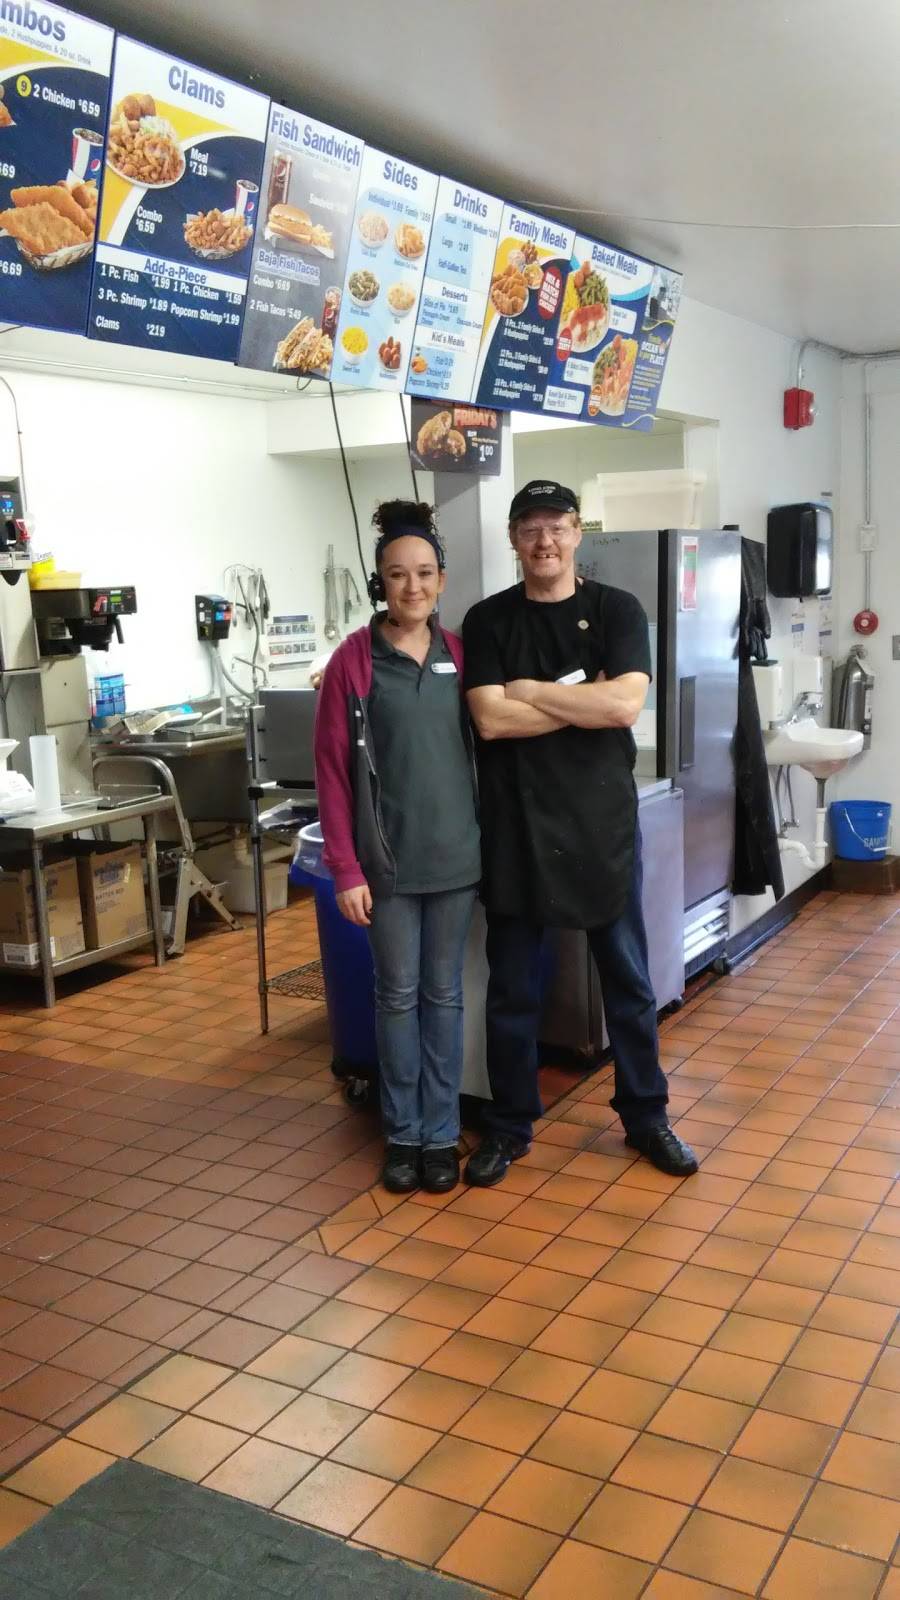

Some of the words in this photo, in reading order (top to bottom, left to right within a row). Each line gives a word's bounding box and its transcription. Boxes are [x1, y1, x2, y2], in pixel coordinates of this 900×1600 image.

[21, 80, 28, 92] 9
[33, 84, 40, 98] 2
[42, 86, 76, 111] Chicken
[169, 65, 226, 109] Clams
[271, 110, 299, 142] Fish
[303, 124, 361, 167] Sandwich
[190, 147, 209, 164] Meal
[383, 160, 418, 191] Sides
[137, 205, 163, 222] Combo
[454, 189, 488, 218] Drinks
[509, 214, 541, 242] Family
[542, 226, 568, 250] Meals
[144, 257, 207, 284] Add-a-Piece
[259, 250, 277, 266] Baja
[279, 256, 296, 271] Fish
[297, 261, 320, 277] Tacos
[592, 245, 617, 267] Baked
[617, 254, 638, 275] Meals
[101, 265, 106, 276] 1
[109, 267, 121, 279] Pc.
[123, 269, 139, 283] Fish
[253, 275, 275, 289] Combo
[98, 287, 104, 300] 3
[106, 289, 118, 303] Pc.
[121, 292, 147, 310] Shrimp
[174, 280, 179, 292] 1
[180, 282, 191, 295] Pc.
[192, 285, 219, 301] Chicken
[441, 286, 468, 303] Desserts
[170, 302, 199, 319] Popcorn
[200, 308, 223, 326] Shrimp
[250, 300, 255, 310] 2
[256, 301, 269, 313] Fish
[270, 304, 286, 317] Tacos
[95, 314, 120, 330] Clams
[432, 331, 446, 343] Kid's
[447, 335, 465, 347] Meals
